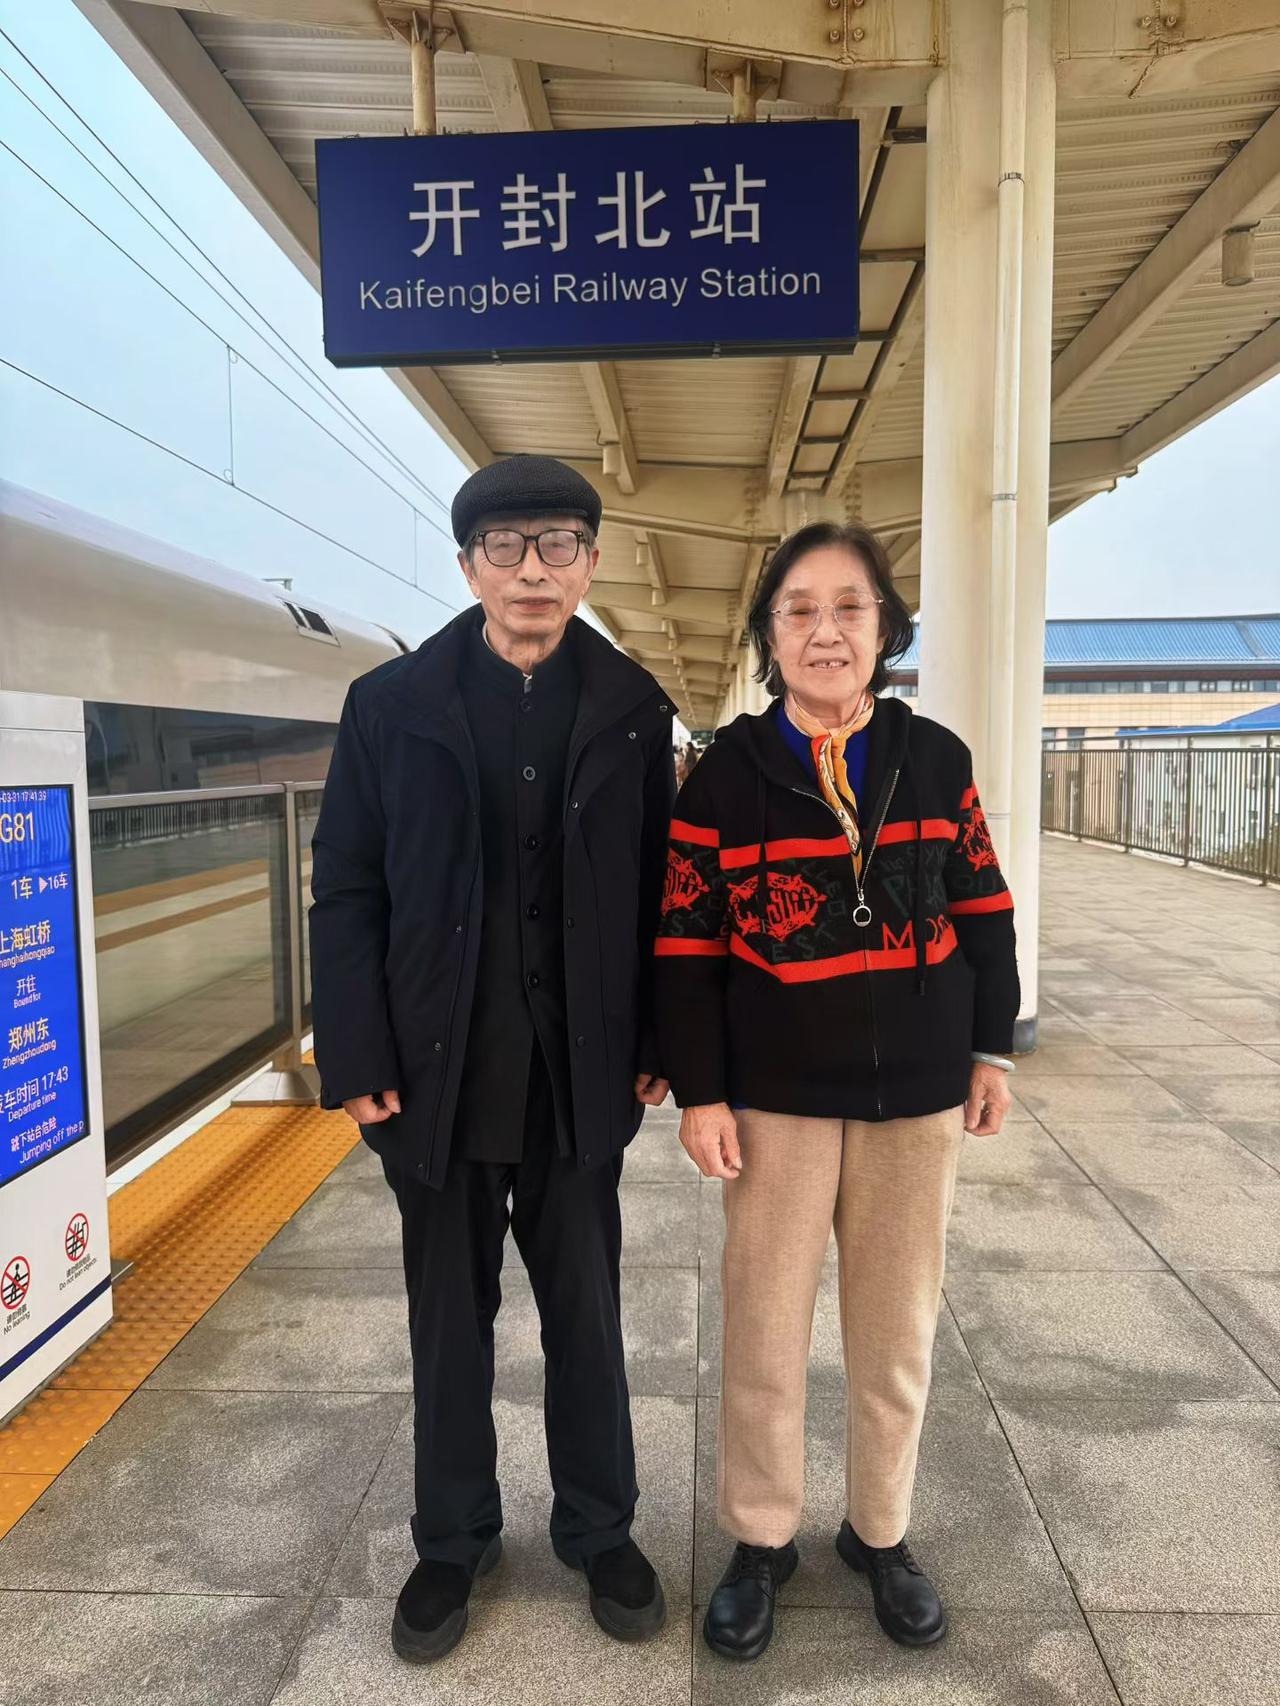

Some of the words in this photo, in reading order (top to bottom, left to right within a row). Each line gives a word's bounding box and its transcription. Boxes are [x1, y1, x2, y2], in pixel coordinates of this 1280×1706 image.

[408, 163, 767, 257] 开封北站
[359, 275, 540, 313] Kaifengbei
[553, 272, 688, 307] Railway
[699, 266, 821, 298] Station
[0, 812, 34, 843] G81
[11, 876, 33, 900] 1车
[47, 872, 68, 890] 16车
[0, 920, 51, 954] 上海虹桥
[16, 974, 37, 996] 开往
[8, 1017, 49, 1053] 郑州东
[3, 1039, 57, 1070] Zhengzhoudong
[41, 1066, 69, 1091] 17:43
[8, 1098, 42, 1122] Departure
[42, 1091, 57, 1106] time
[19, 1139, 52, 1164] Jumping
[53, 1128, 65, 1146] off
